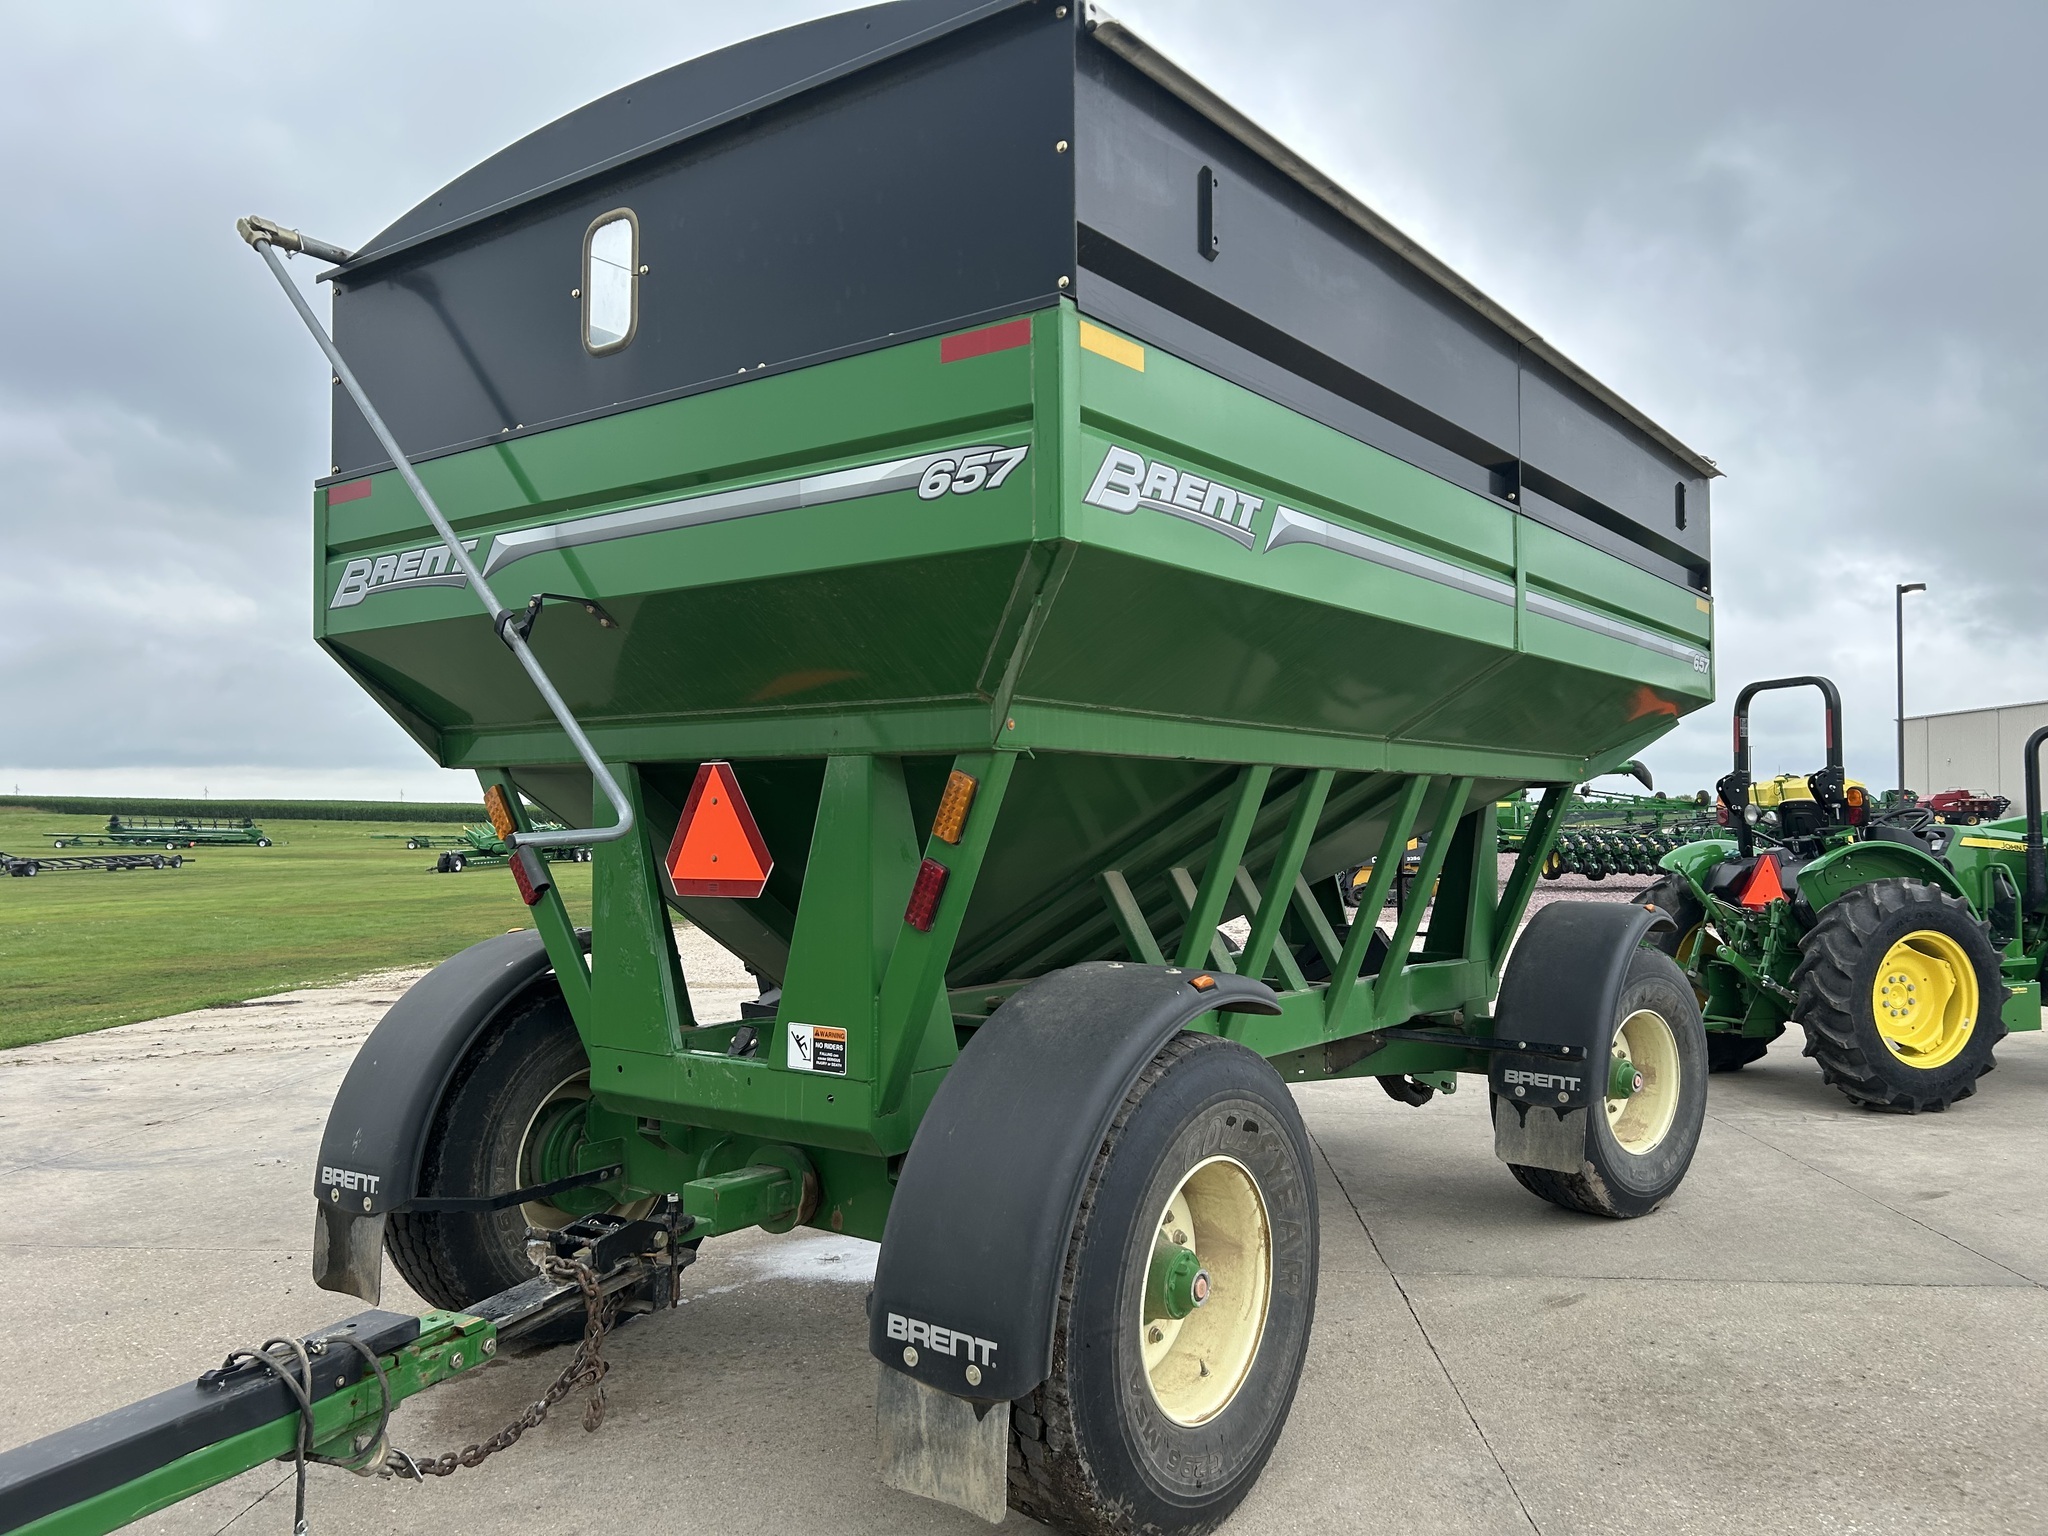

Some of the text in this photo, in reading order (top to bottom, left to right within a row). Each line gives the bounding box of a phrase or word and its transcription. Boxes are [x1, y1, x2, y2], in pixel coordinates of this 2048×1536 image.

[918, 444, 1031, 500] 657
[1083, 444, 1264, 533] BRENT
[1693, 653, 1710, 675] 657
[2001, 842, 2022, 851] JOHN
[815, 1041, 844, 1051] NO RIDERS
[820, 1030, 845, 1040] WARNING
[1182, 1110, 1304, 1298] GOODYEAR
